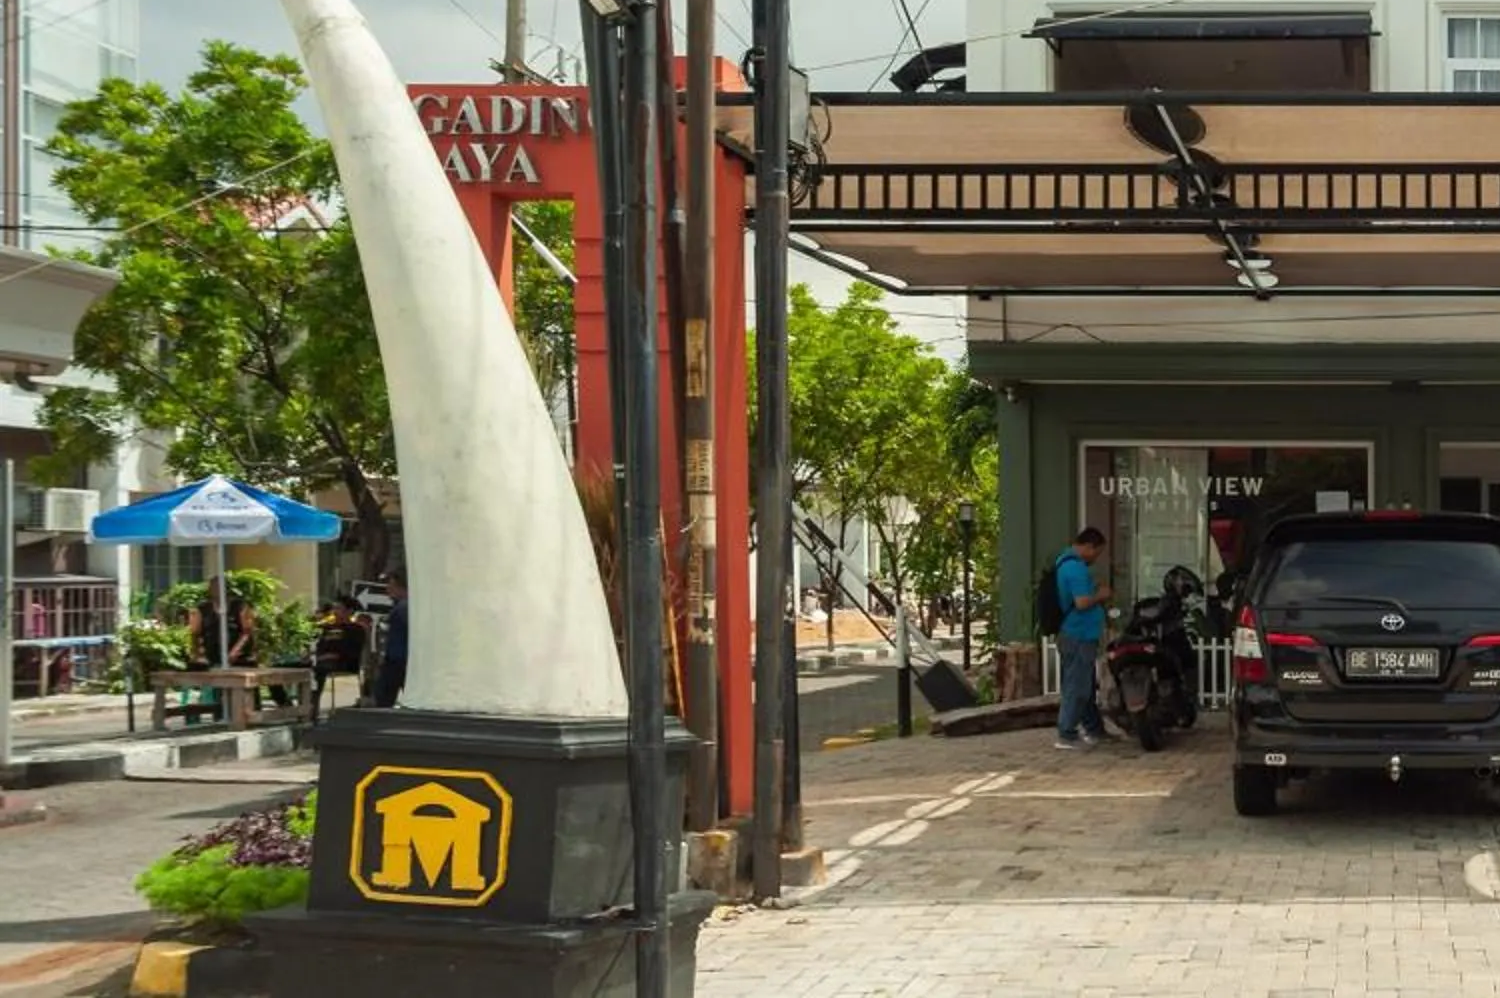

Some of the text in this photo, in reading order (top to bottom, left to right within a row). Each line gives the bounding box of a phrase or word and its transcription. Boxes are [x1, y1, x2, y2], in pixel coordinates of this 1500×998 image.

[412, 94, 593, 135] GADIN
[443, 143, 541, 183] AYA
[1099, 476, 1264, 496] URBAN VIEW
[1351, 652, 1368, 668] BE
